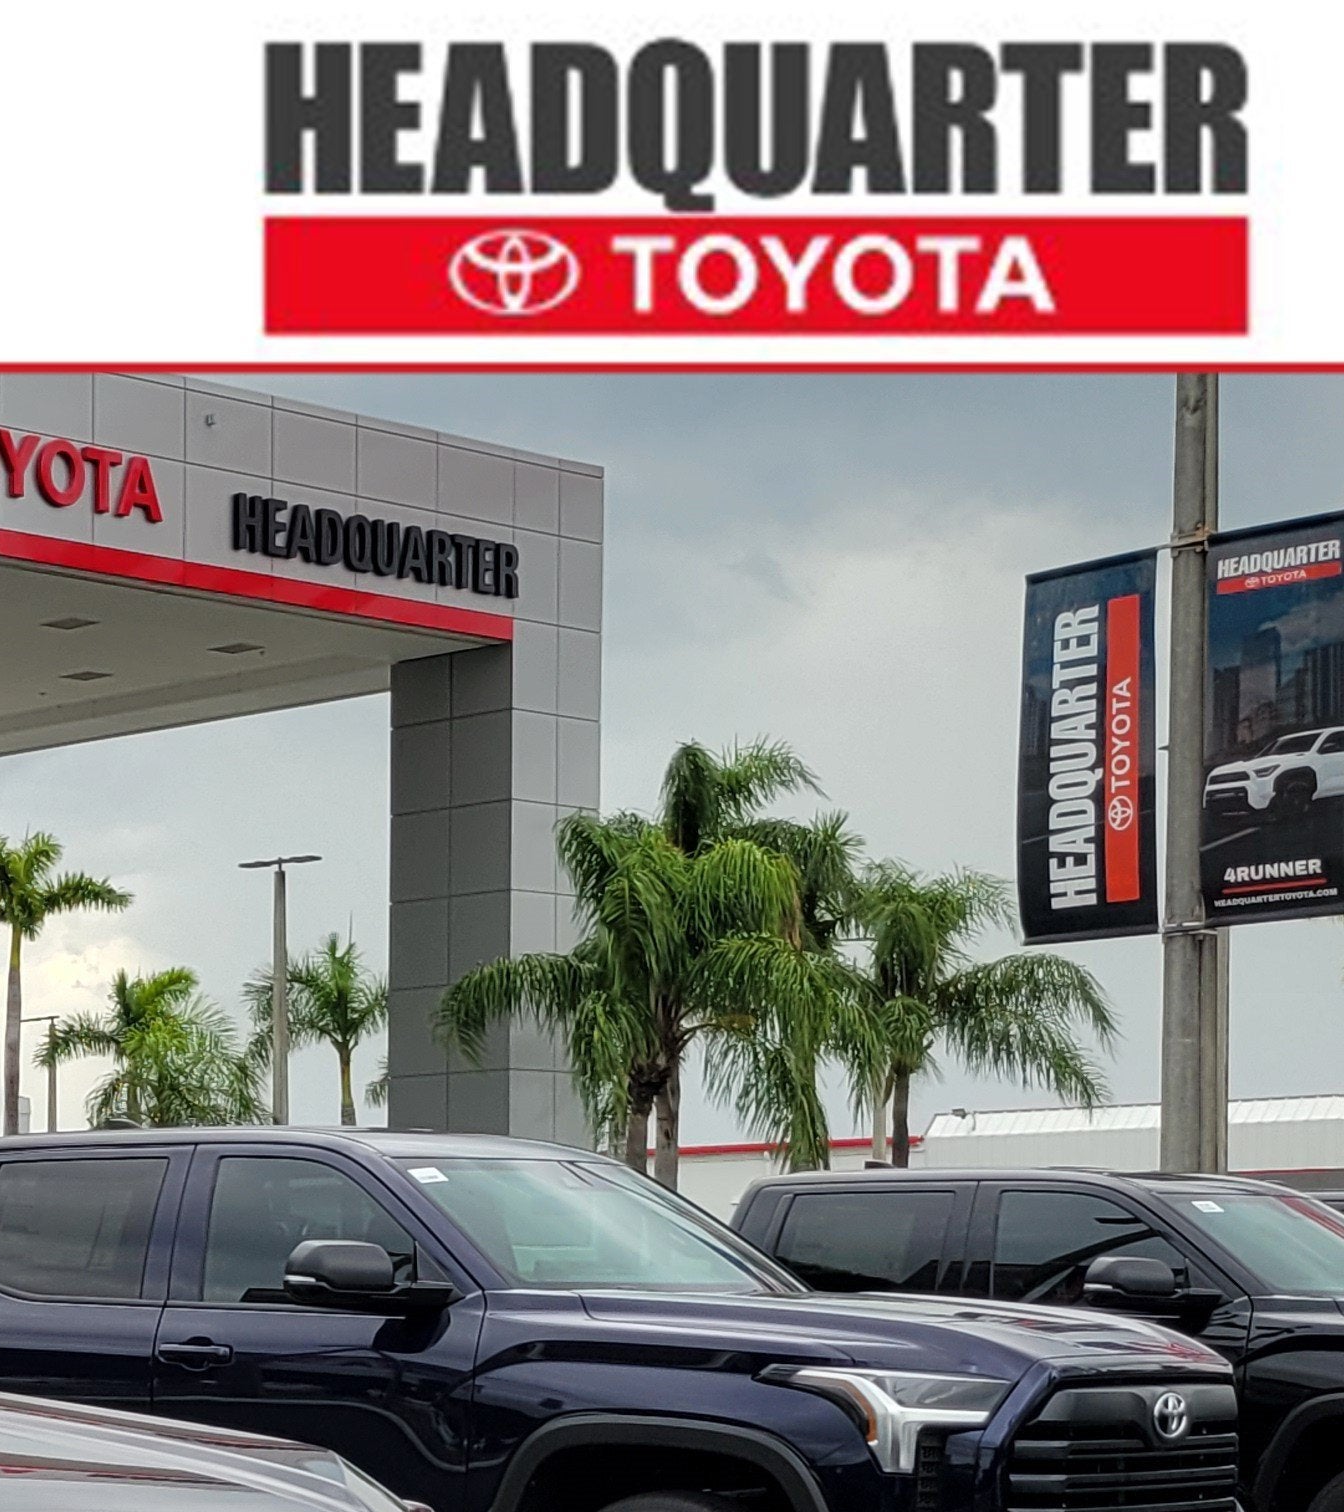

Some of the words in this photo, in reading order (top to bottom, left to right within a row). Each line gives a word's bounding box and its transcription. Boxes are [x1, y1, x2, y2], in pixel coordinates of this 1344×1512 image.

[232, 492, 520, 599] HEADQUARTER
[1216, 539, 1341, 580] HEADQUARTER
[1261, 569, 1308, 586] TOYOTA
[1110, 676, 1132, 793] TOYOTA
[1048, 603, 1104, 911] HEADQUARTER
[1224, 858, 1322, 883] 4RUNNER
[1214, 887, 1338, 908] HEADQUARTERTOYOTA.COM
